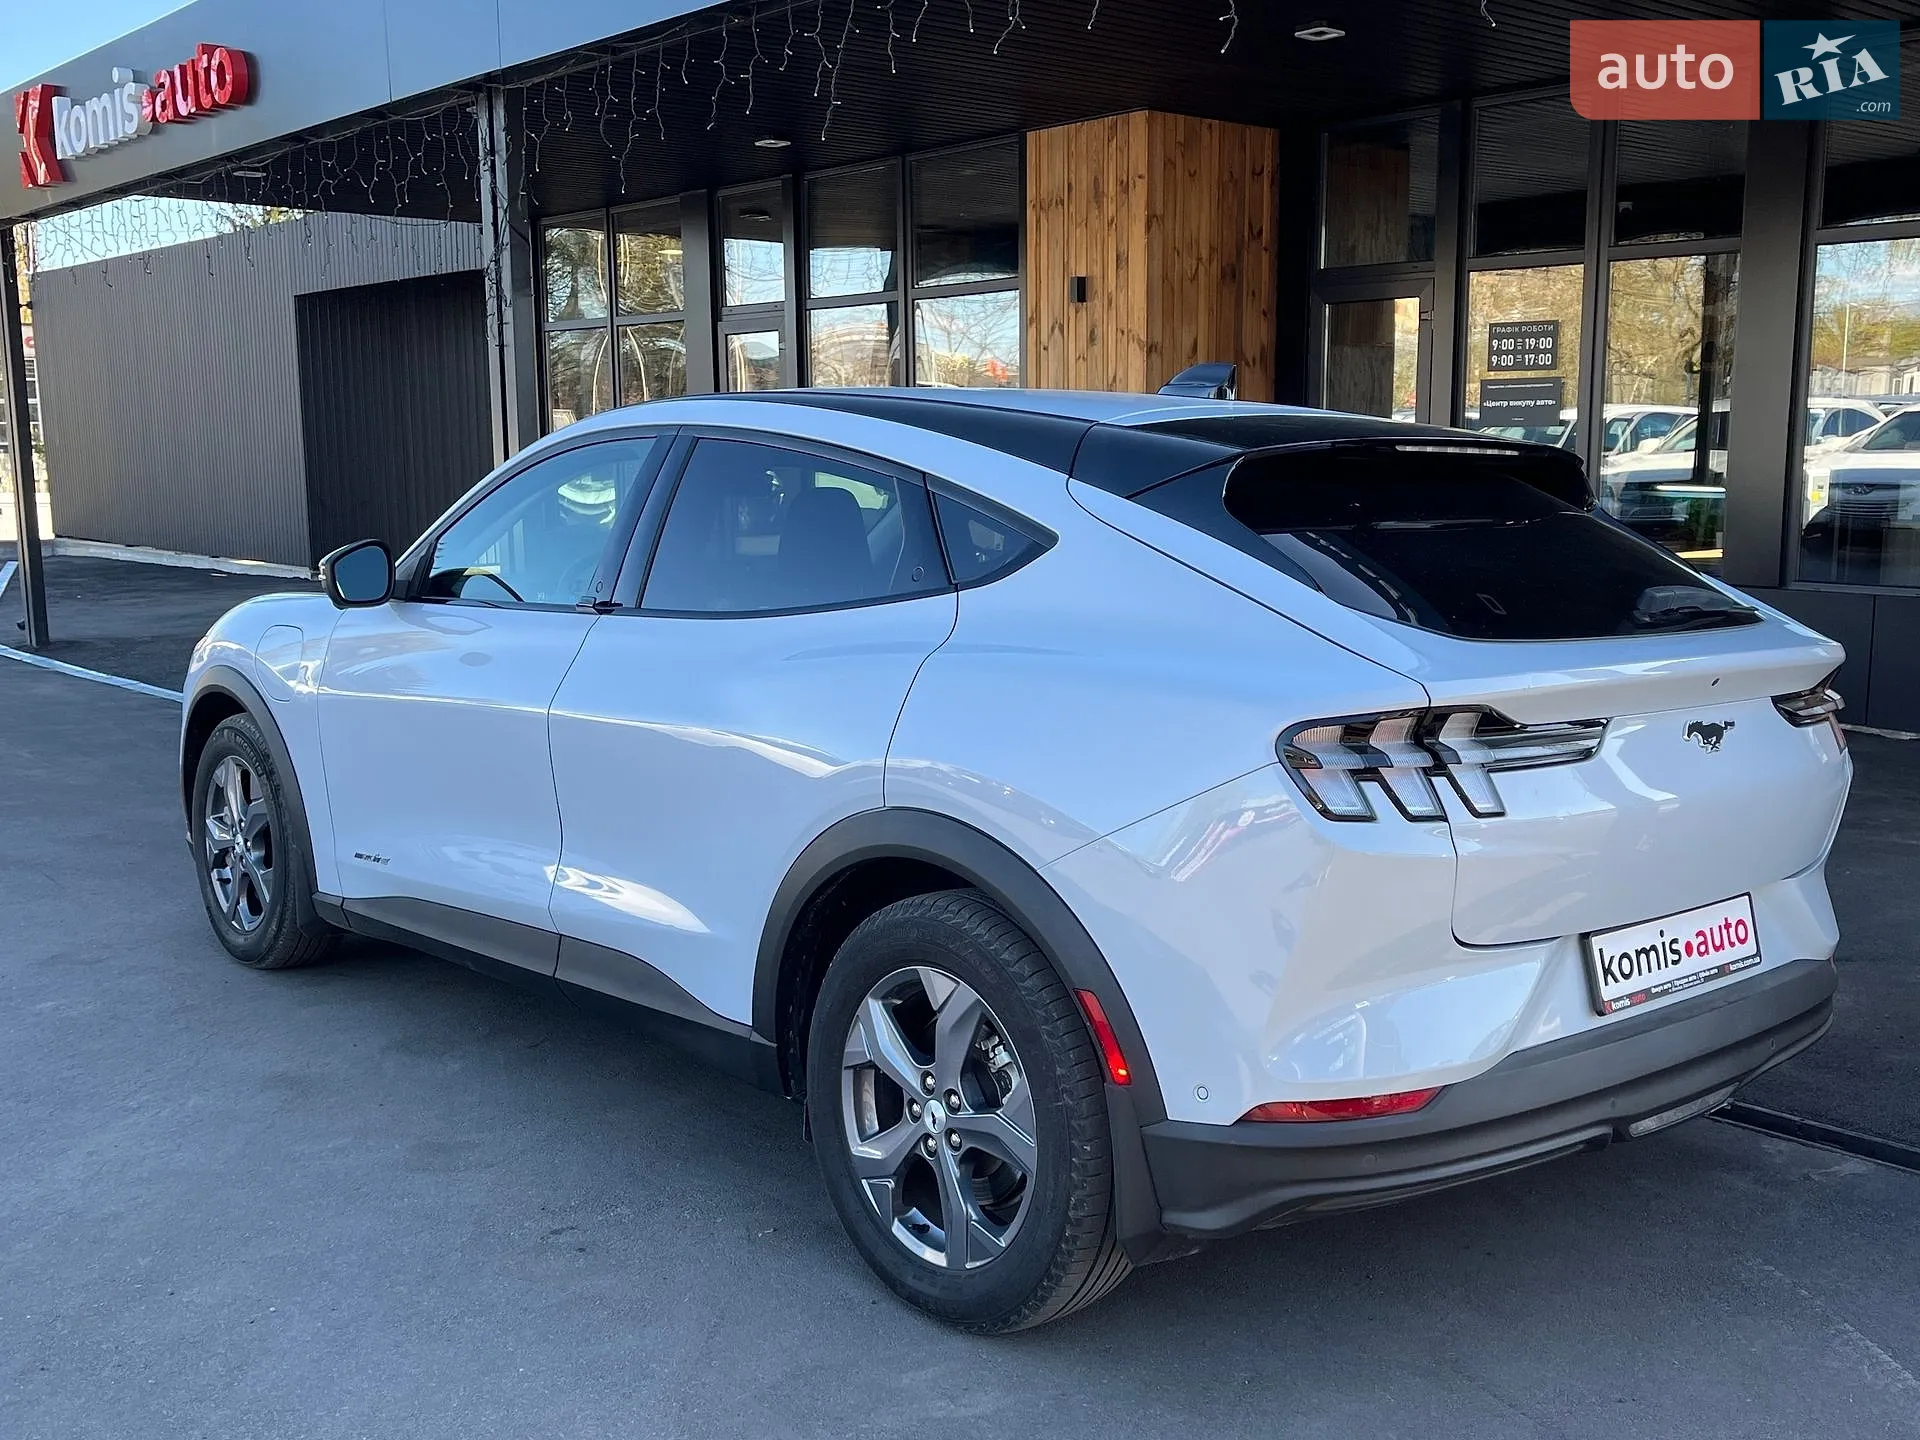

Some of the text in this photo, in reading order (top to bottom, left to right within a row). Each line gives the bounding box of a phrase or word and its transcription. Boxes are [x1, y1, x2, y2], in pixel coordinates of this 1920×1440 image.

[1492, 337, 1553, 350] 9:00 19:00
[1491, 353, 1552, 366] 9:00 17:00
